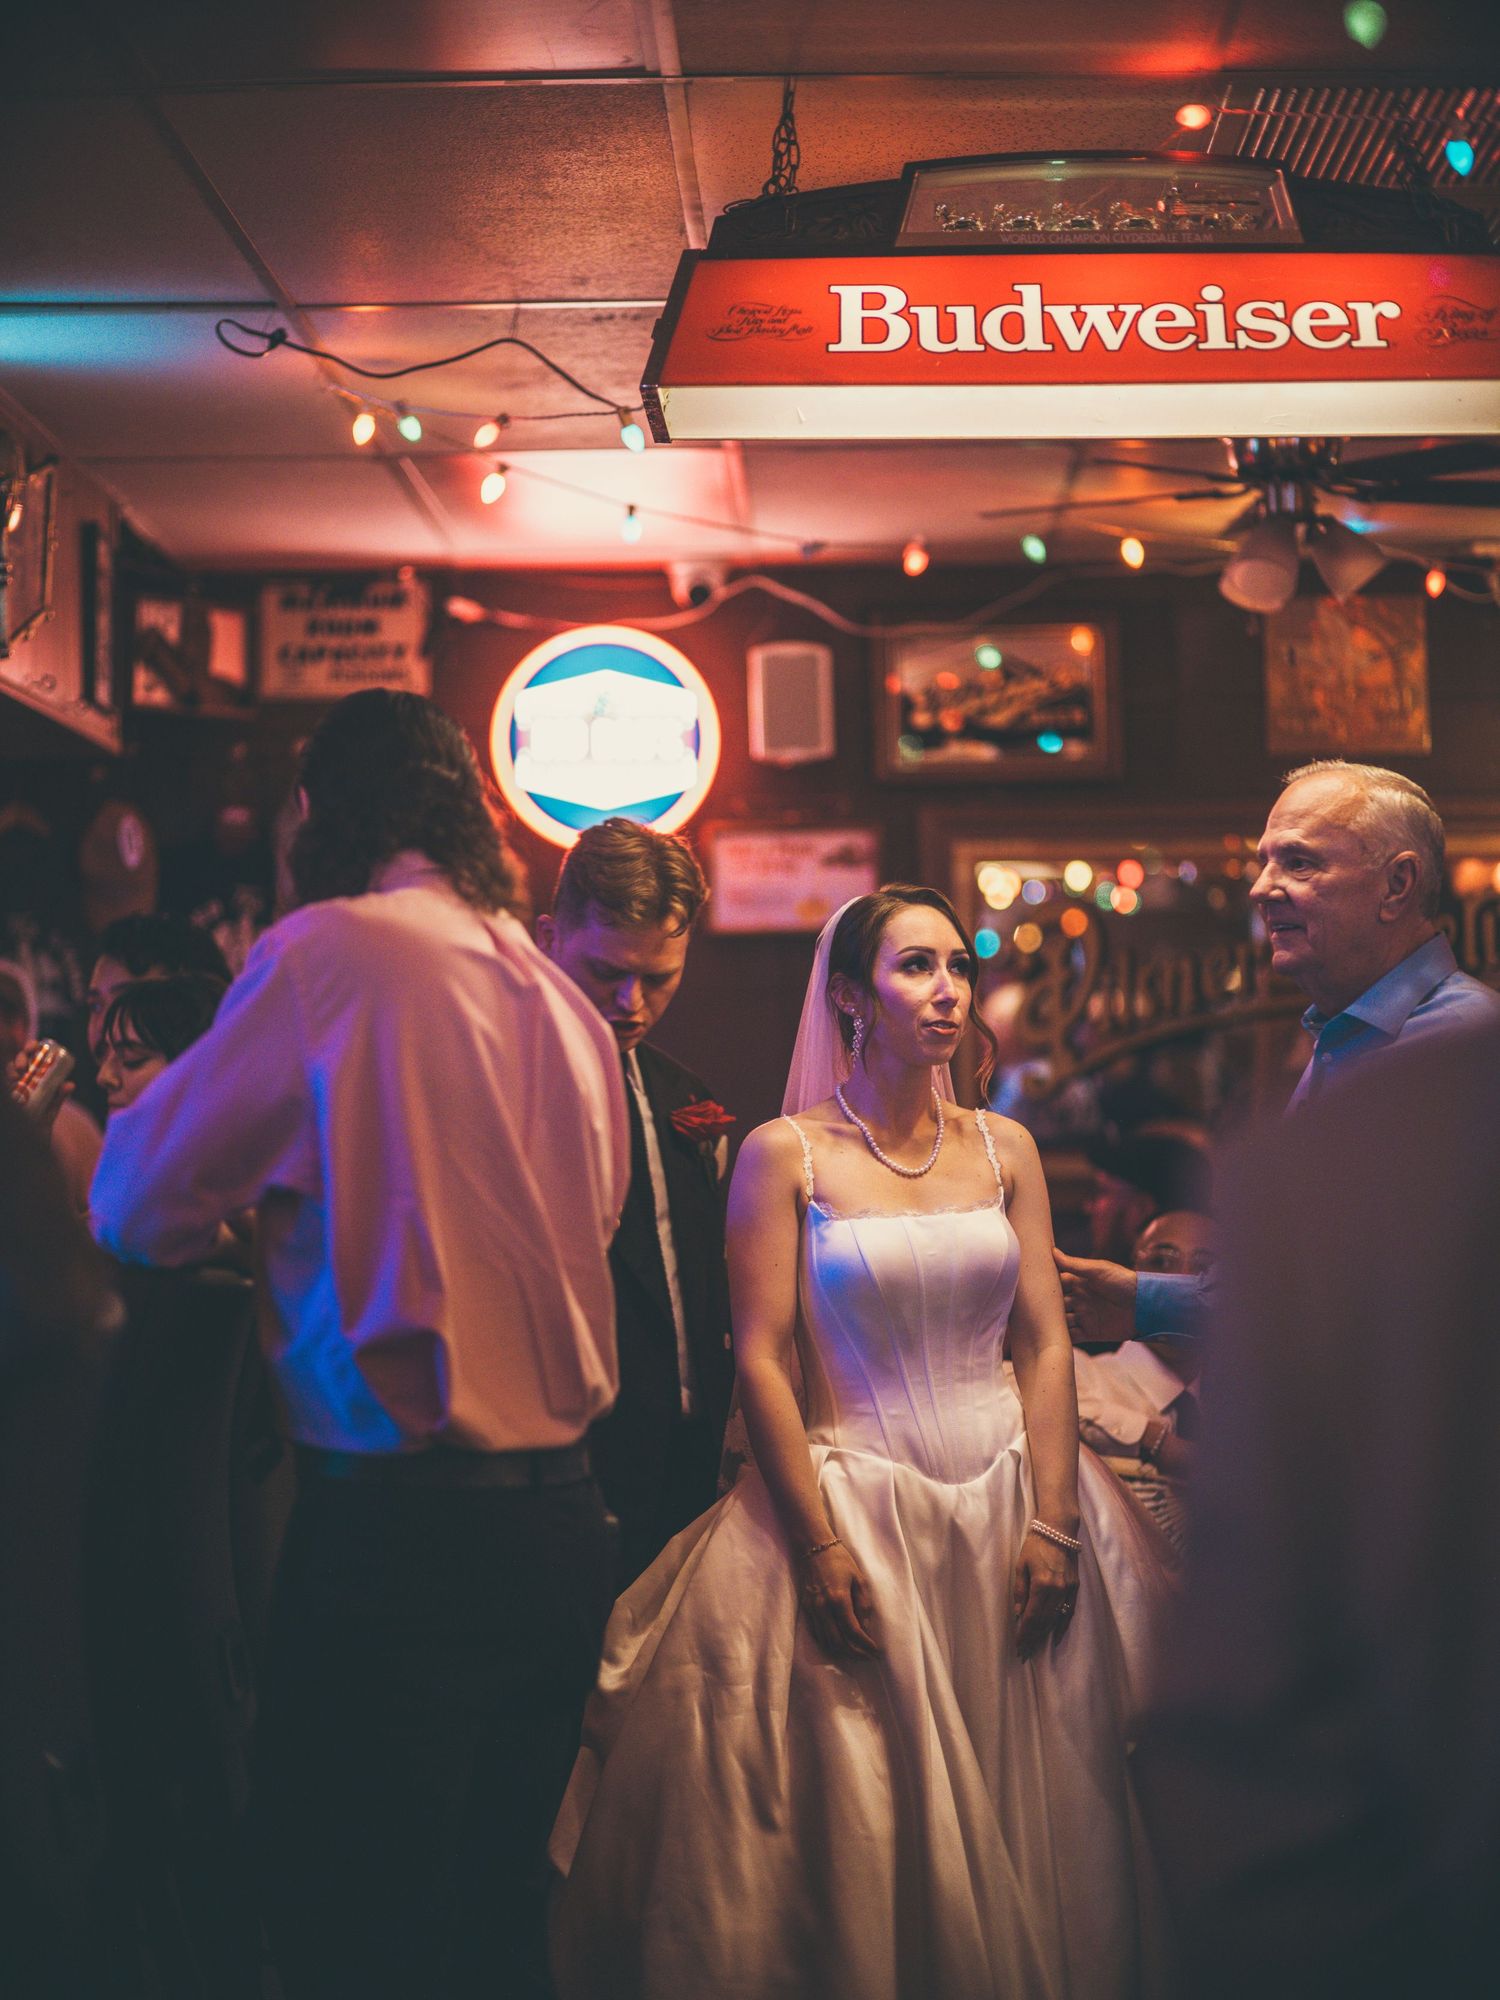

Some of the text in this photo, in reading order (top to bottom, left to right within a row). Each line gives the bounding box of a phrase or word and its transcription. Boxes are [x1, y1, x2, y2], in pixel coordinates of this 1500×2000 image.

[1049, 233, 1109, 244] CHAMPION
[1112, 232, 1179, 244] CLYDESDALE
[1182, 232, 1214, 243] TEAM
[826, 282, 1402, 354] Budweiser
